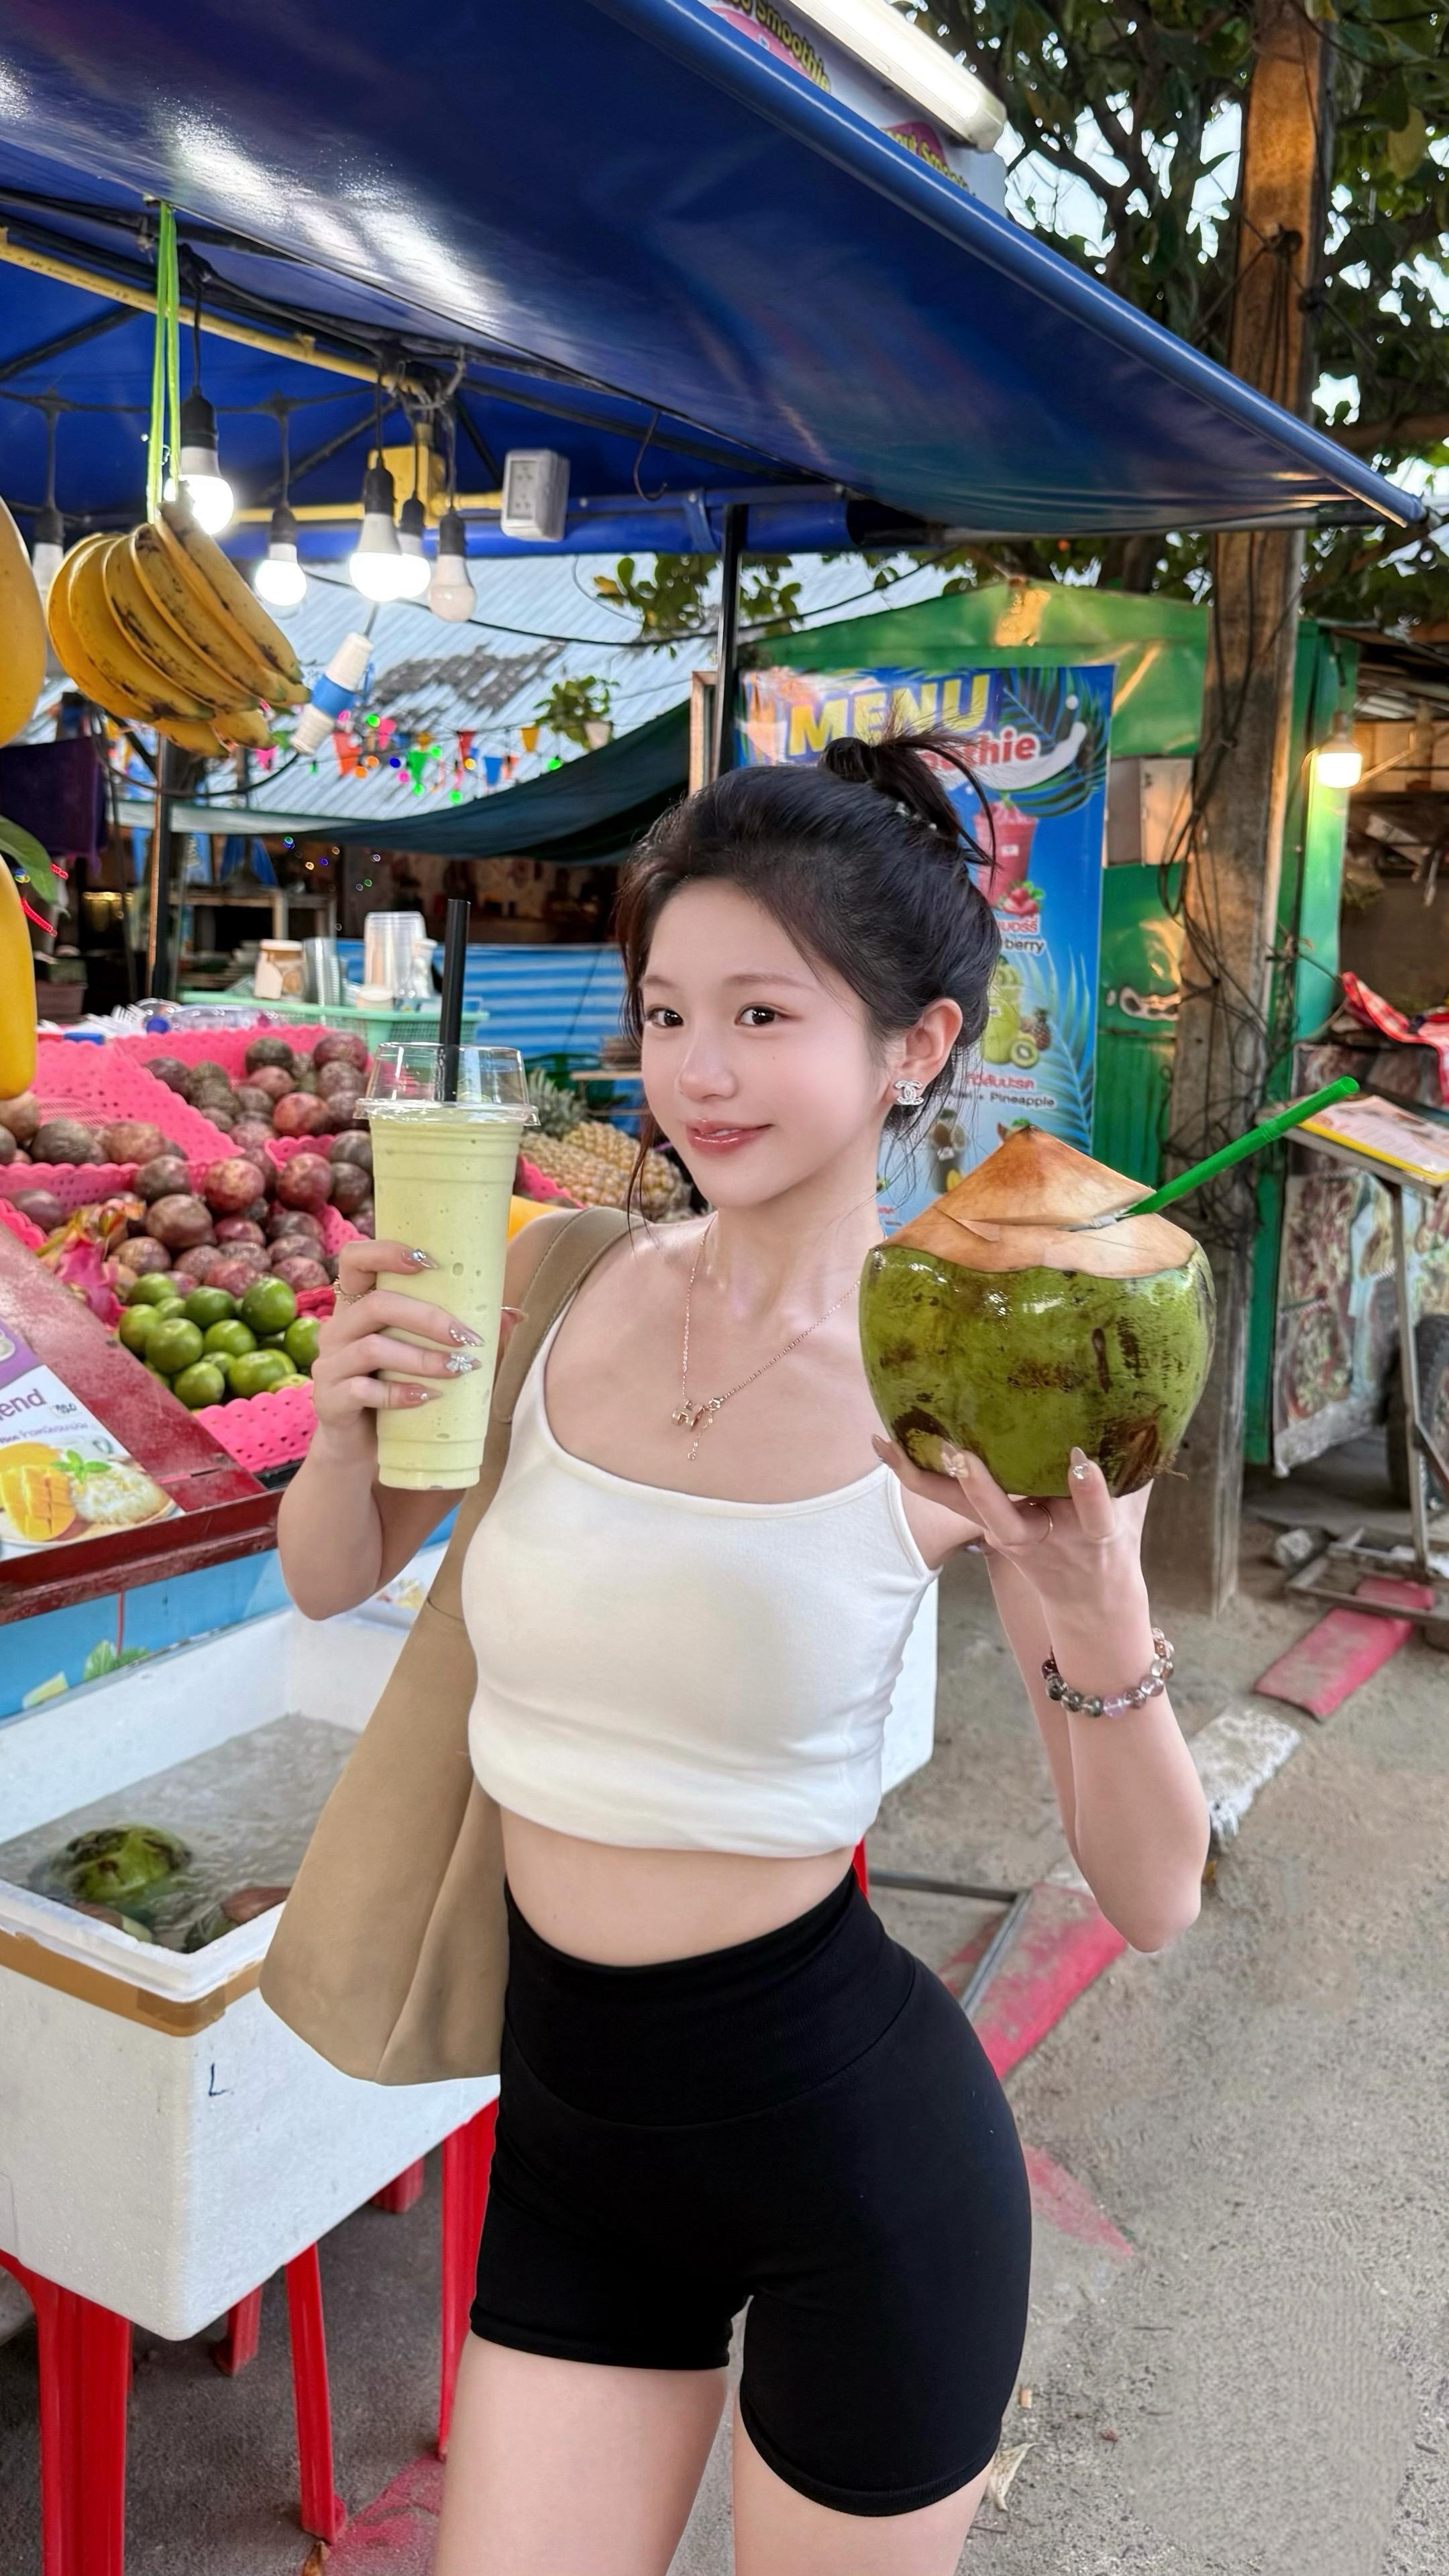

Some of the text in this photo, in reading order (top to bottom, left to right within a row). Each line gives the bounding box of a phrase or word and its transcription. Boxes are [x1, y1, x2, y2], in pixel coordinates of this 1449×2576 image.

[788, 674, 989, 756] MENU
[1004, 938, 1044, 954] berry
[990, 1091, 1055, 1107] Pineapple
[0, 1388, 47, 1421] end
